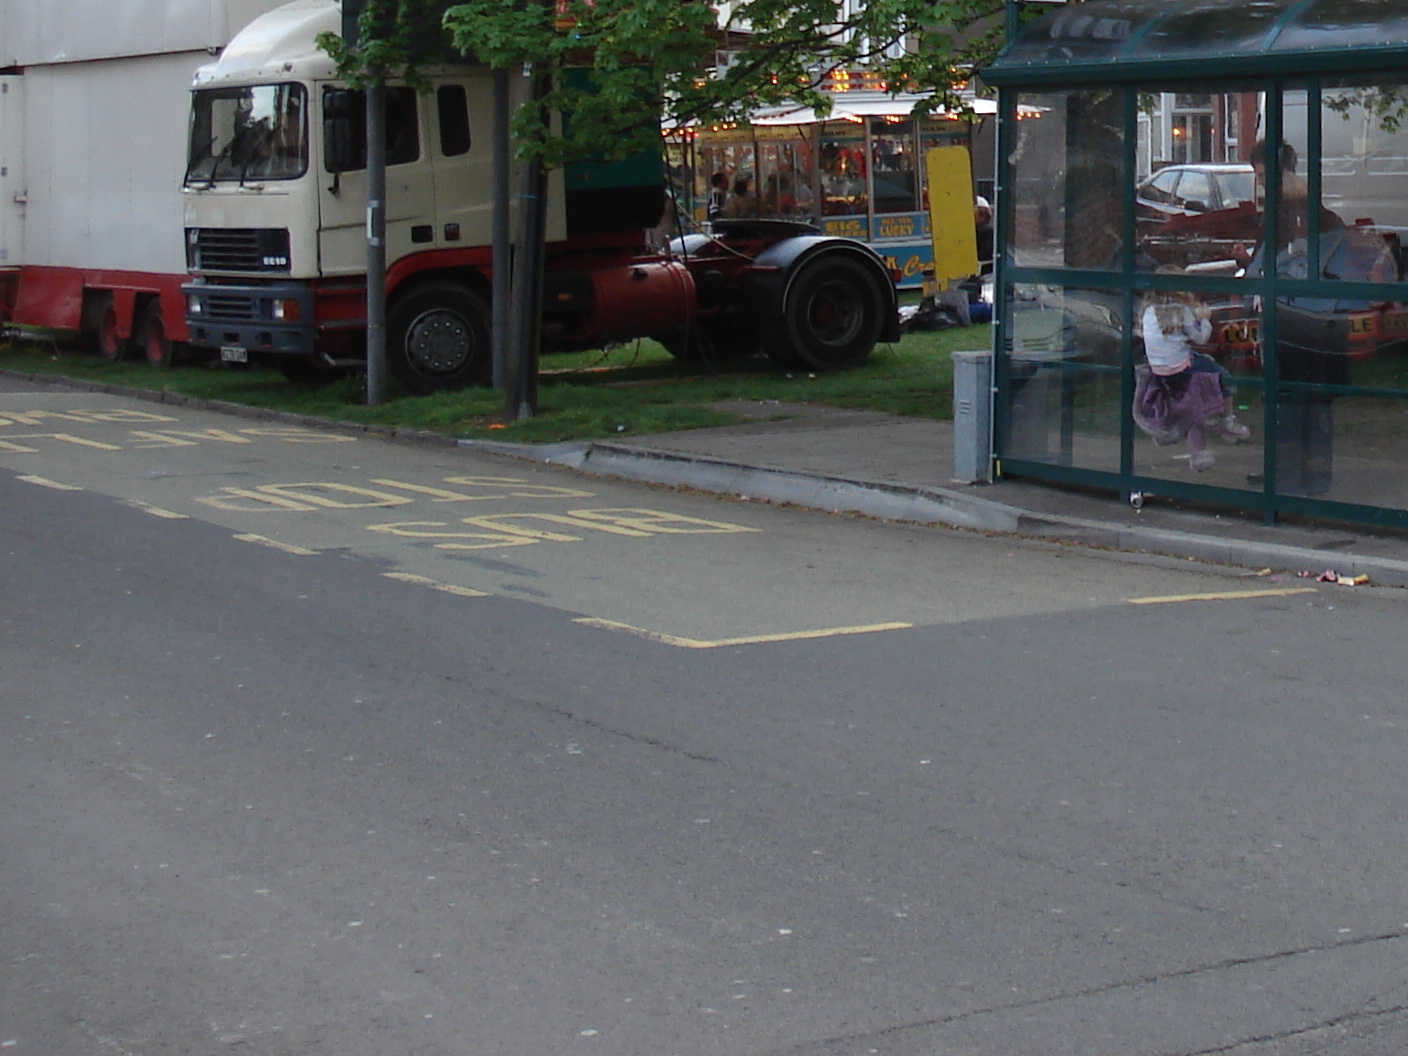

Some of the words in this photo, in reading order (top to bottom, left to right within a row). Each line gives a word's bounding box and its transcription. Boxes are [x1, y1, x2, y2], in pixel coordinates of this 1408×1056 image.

[879, 224, 915, 236] LUCKY
[194, 476, 597, 513] STOP
[365, 507, 764, 550] BUS
